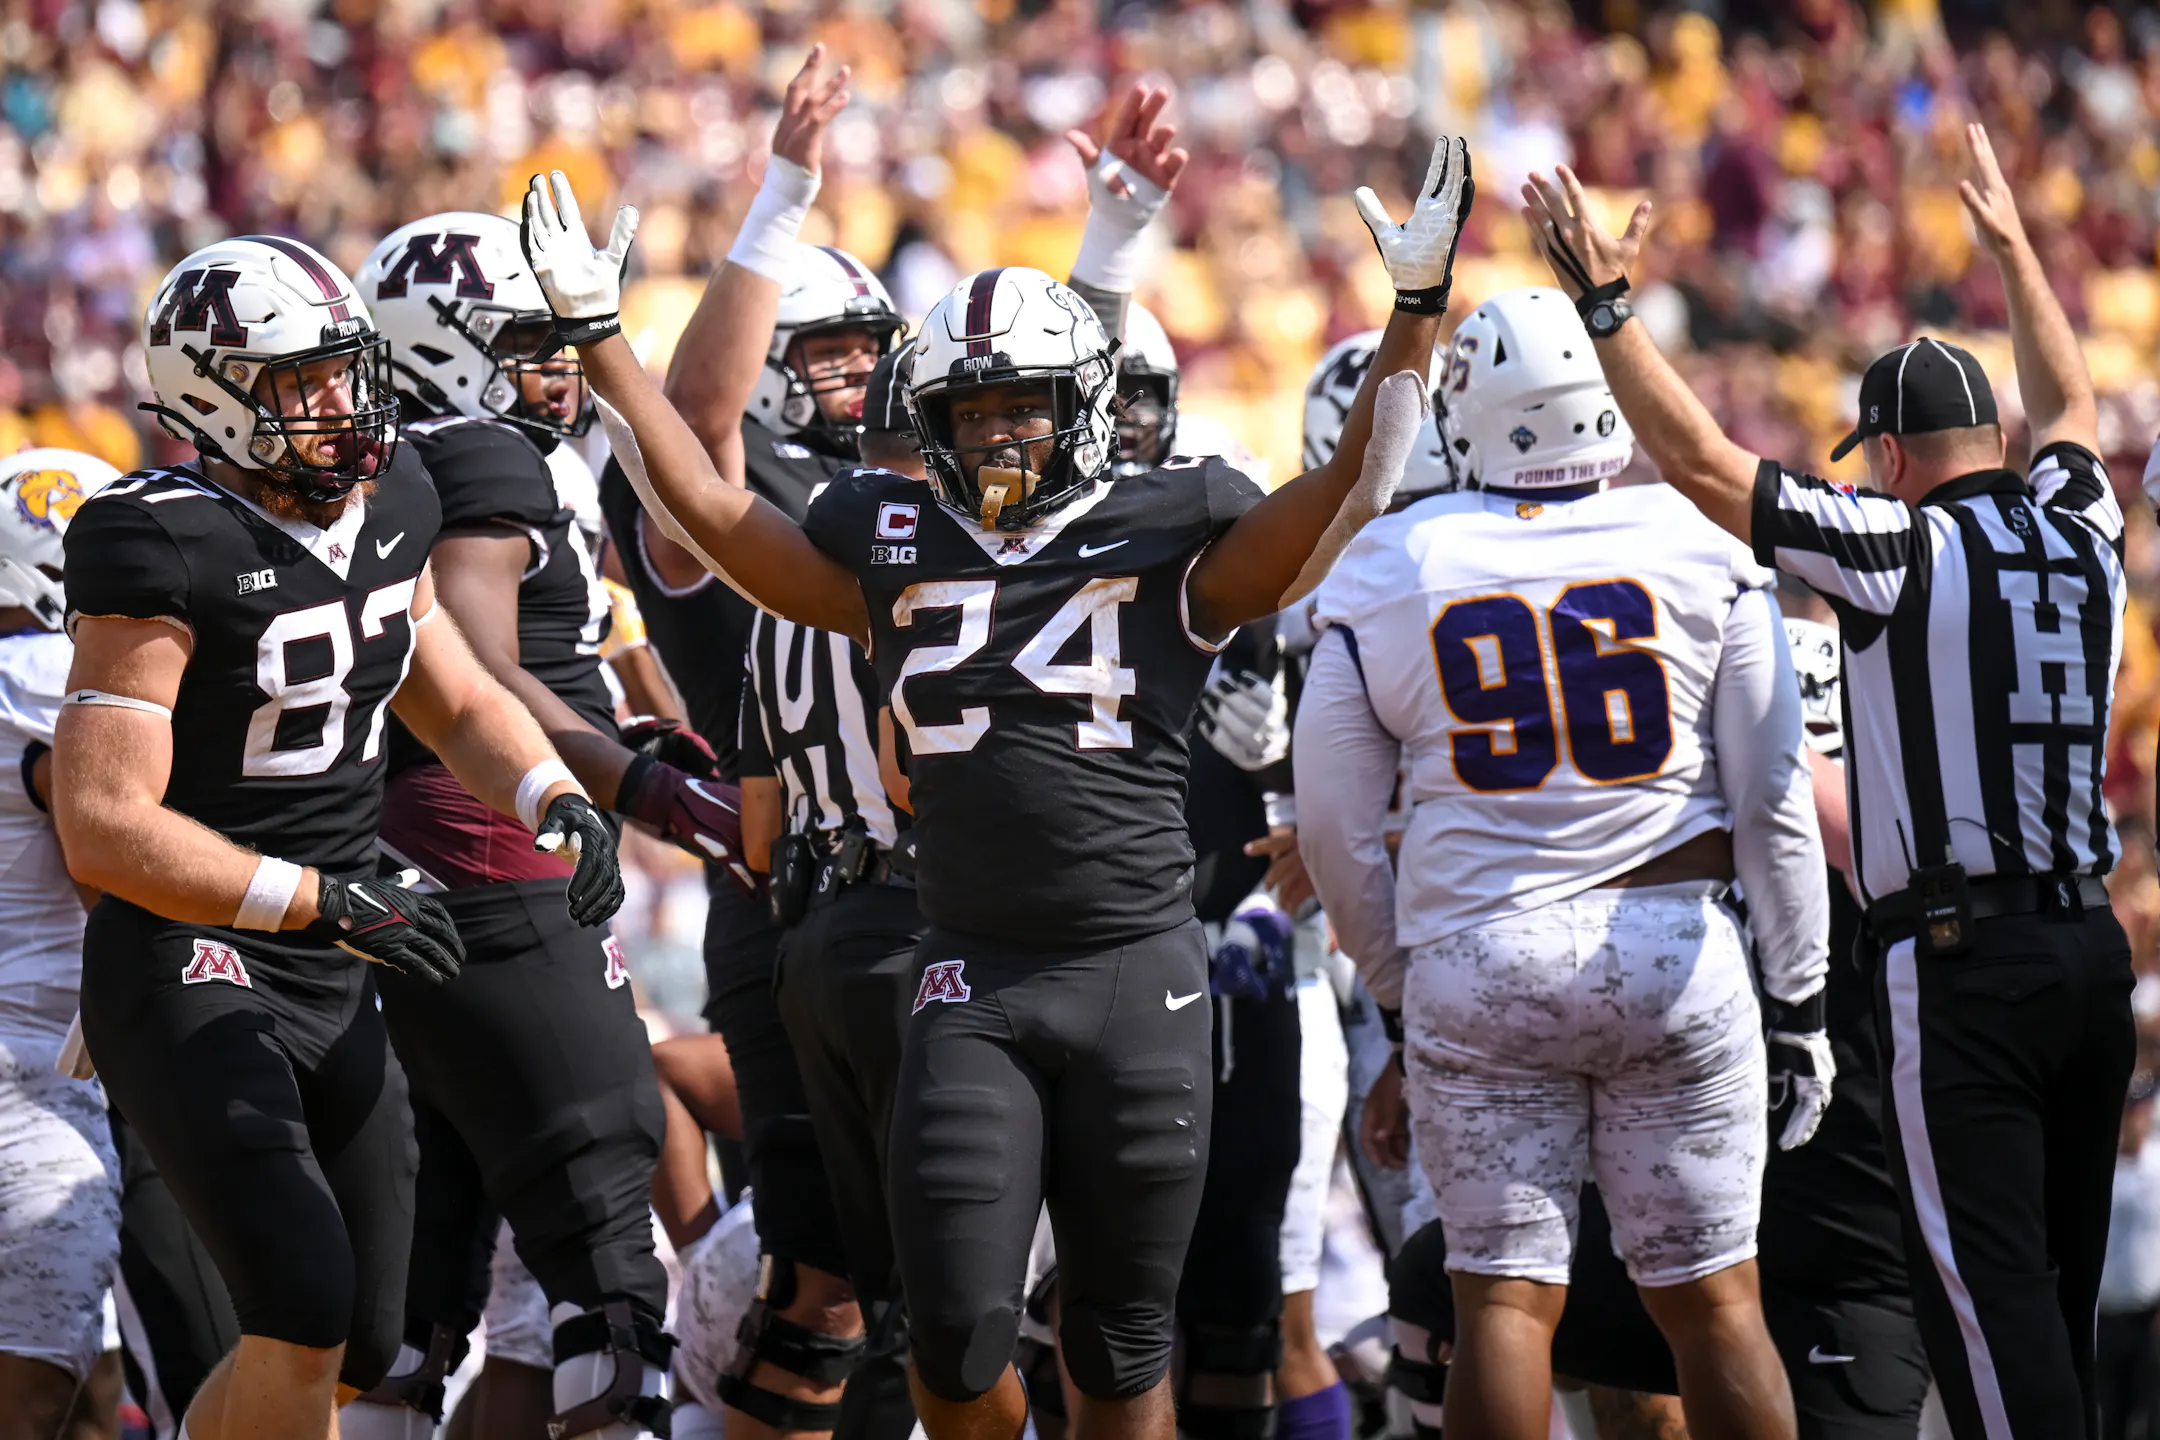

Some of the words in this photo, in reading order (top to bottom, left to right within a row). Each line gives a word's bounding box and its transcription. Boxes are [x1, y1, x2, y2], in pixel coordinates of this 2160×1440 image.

[377, 233, 495, 301] M
[150, 269, 248, 348] M
[963, 355, 993, 373] ROW
[1514, 467, 1566, 485] POUND
[1570, 464, 1596, 480] THE
[879, 504, 918, 538] C
[241, 574, 419, 780] 87
[890, 576, 1140, 756] 24
[1998, 569, 2095, 725] H
[1429, 577, 1676, 793] 96
[182, 938, 252, 988] M
[911, 959, 972, 1016] M
